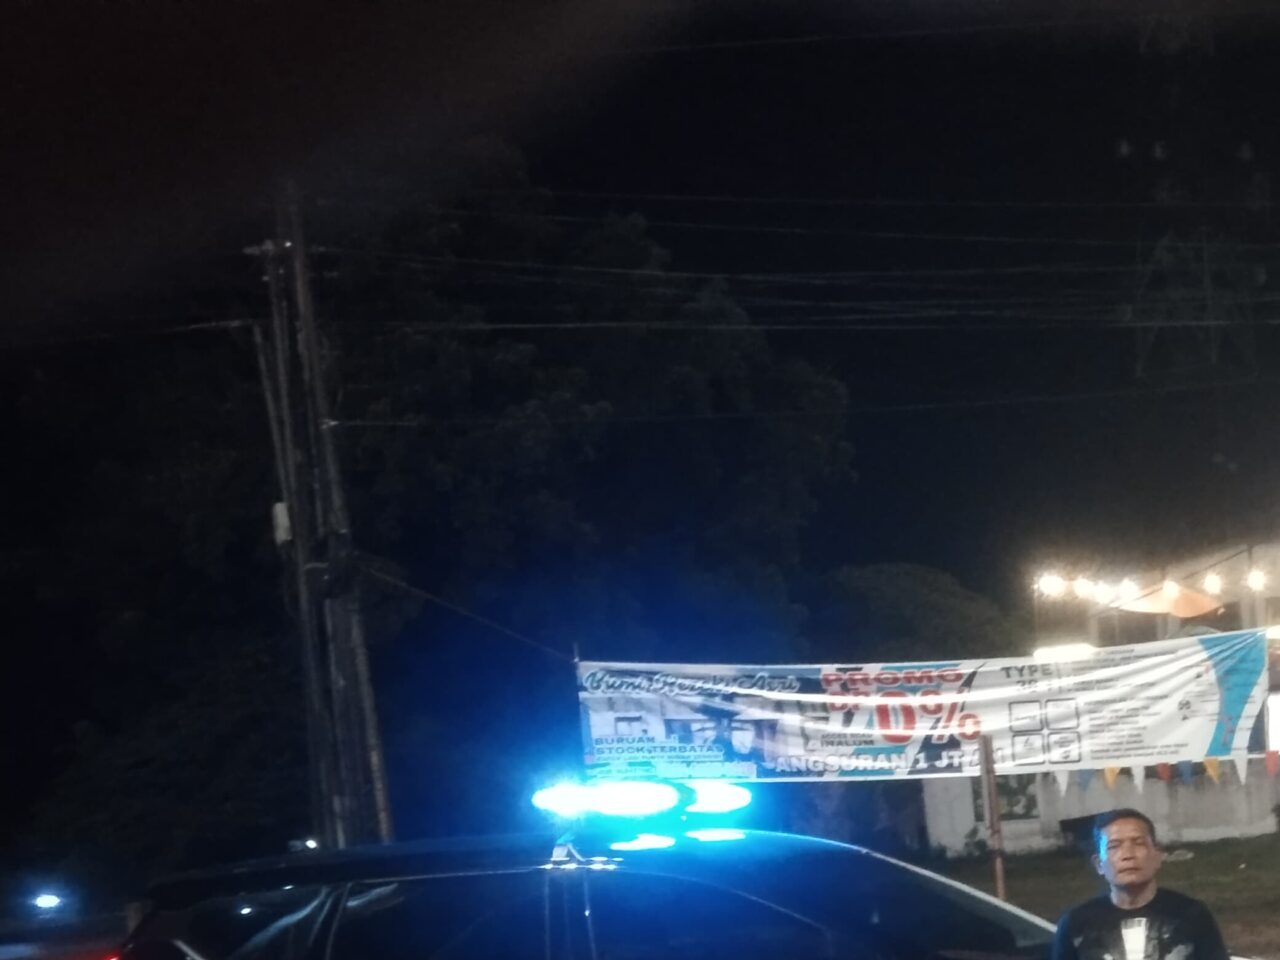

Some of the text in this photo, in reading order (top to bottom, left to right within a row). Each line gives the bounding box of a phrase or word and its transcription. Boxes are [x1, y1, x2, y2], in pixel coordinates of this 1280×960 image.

[821, 668, 963, 688] PROMO
[1001, 663, 1053, 678] TYPE
[875, 689, 982, 744] 0%
[595, 746, 645, 755] STOCK
[776, 753, 906, 773] ANGSURAN
